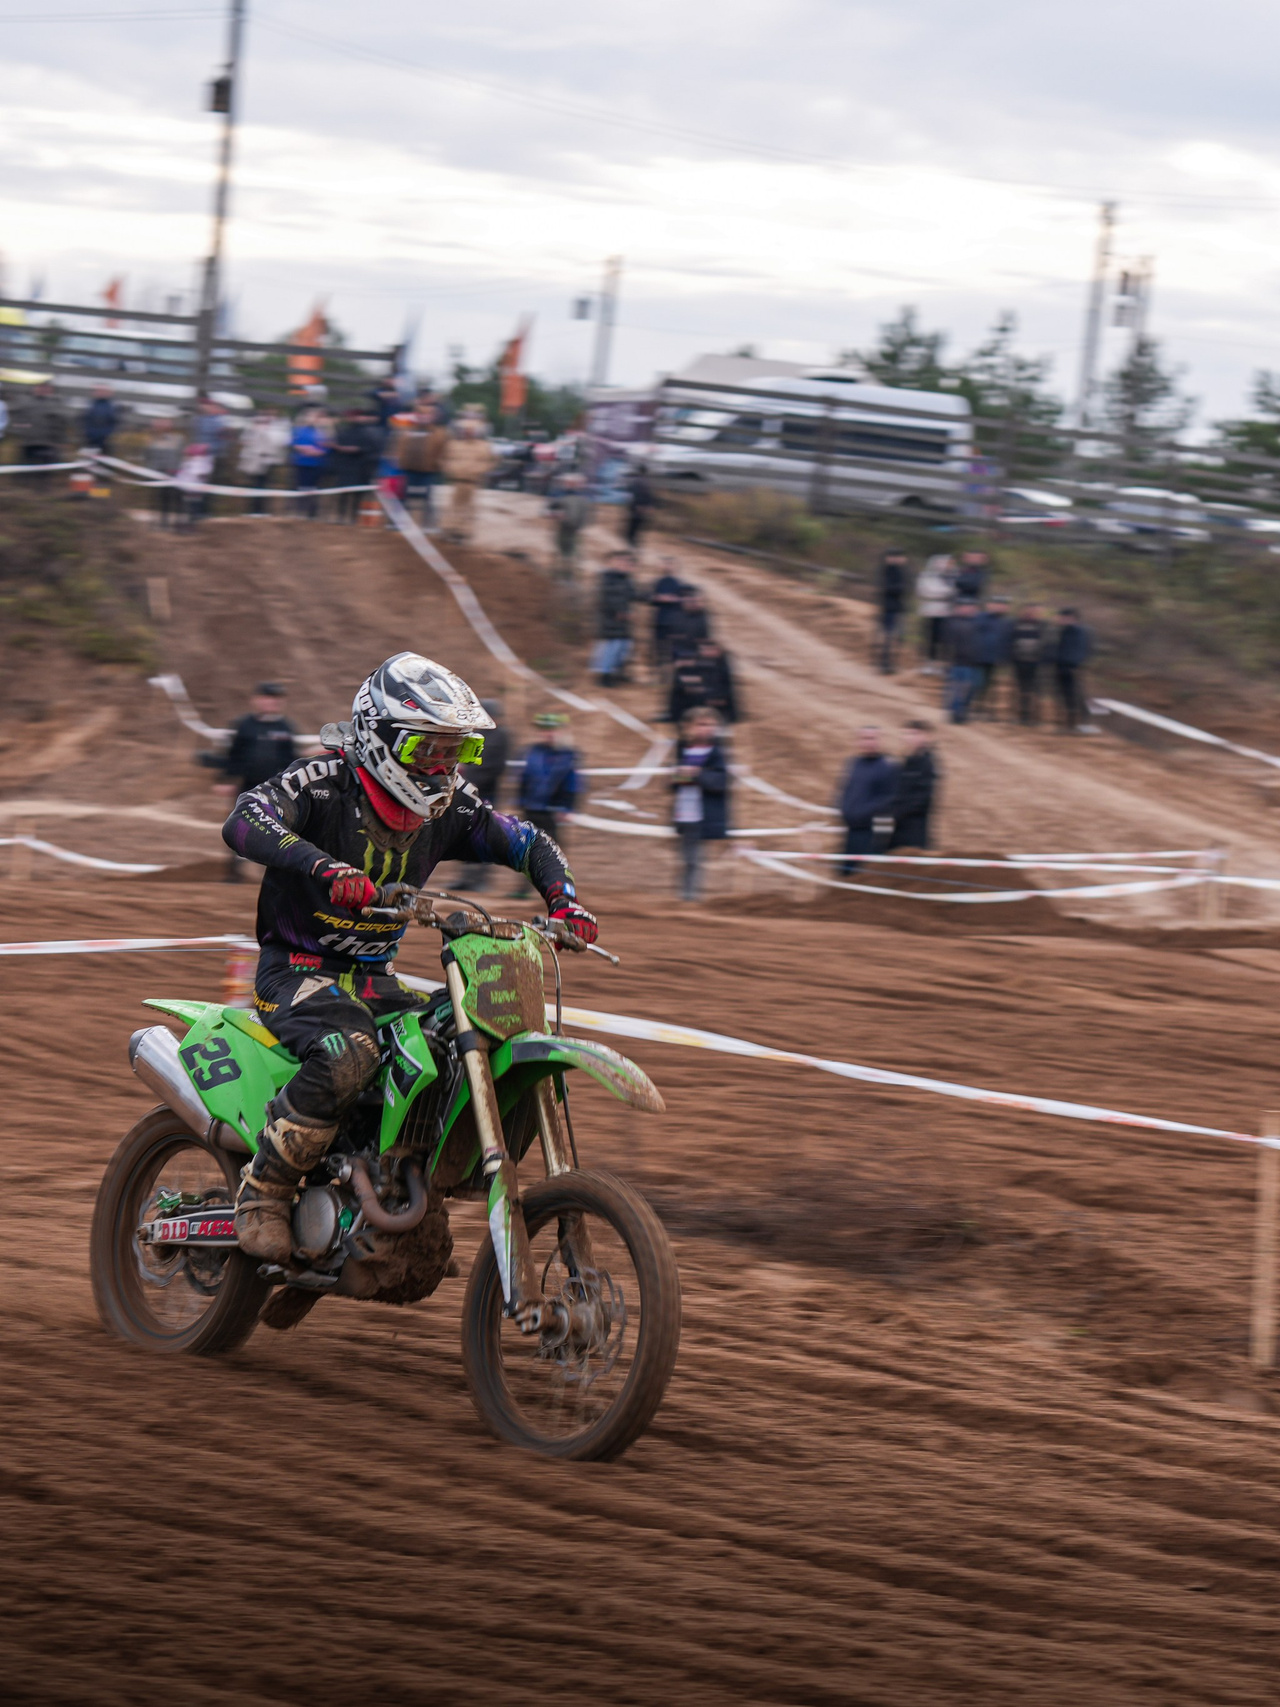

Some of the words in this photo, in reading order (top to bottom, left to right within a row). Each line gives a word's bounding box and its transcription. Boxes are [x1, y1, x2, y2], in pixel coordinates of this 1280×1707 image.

[241, 809, 271, 835] ENERGY
[313, 911, 355, 931] PRO
[353, 922, 402, 934] CIRCU
[289, 952, 322, 970] VANS
[179, 1036, 243, 1091] 29
[395, 1054, 418, 1076] 450
[161, 1221, 188, 1241] DID
[196, 1219, 239, 1237] KEN
